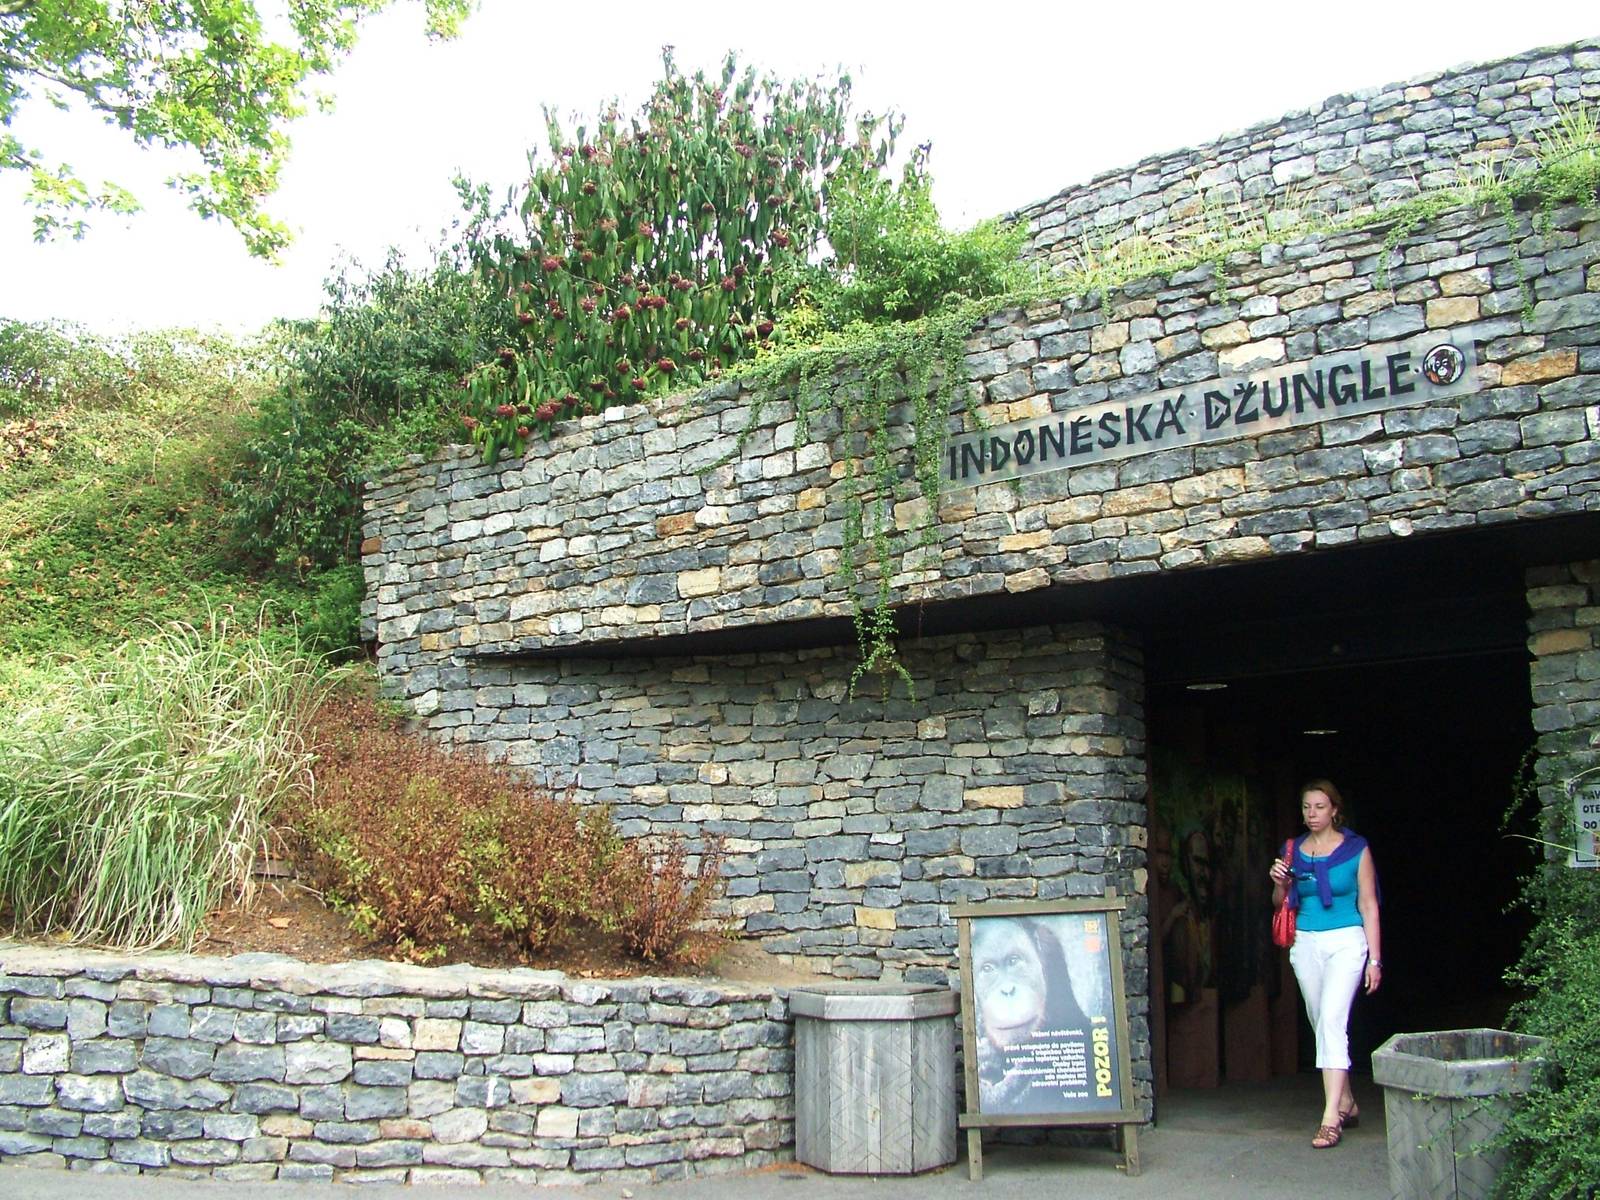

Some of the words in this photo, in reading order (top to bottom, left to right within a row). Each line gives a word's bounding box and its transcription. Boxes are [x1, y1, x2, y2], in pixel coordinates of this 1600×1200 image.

[949, 393, 1187, 481] INDONÉSKÁ
[1204, 350, 1416, 430] DŽUNGLE
[1584, 821, 1597, 829] DO
[1092, 1027, 1113, 1097] POZOR
